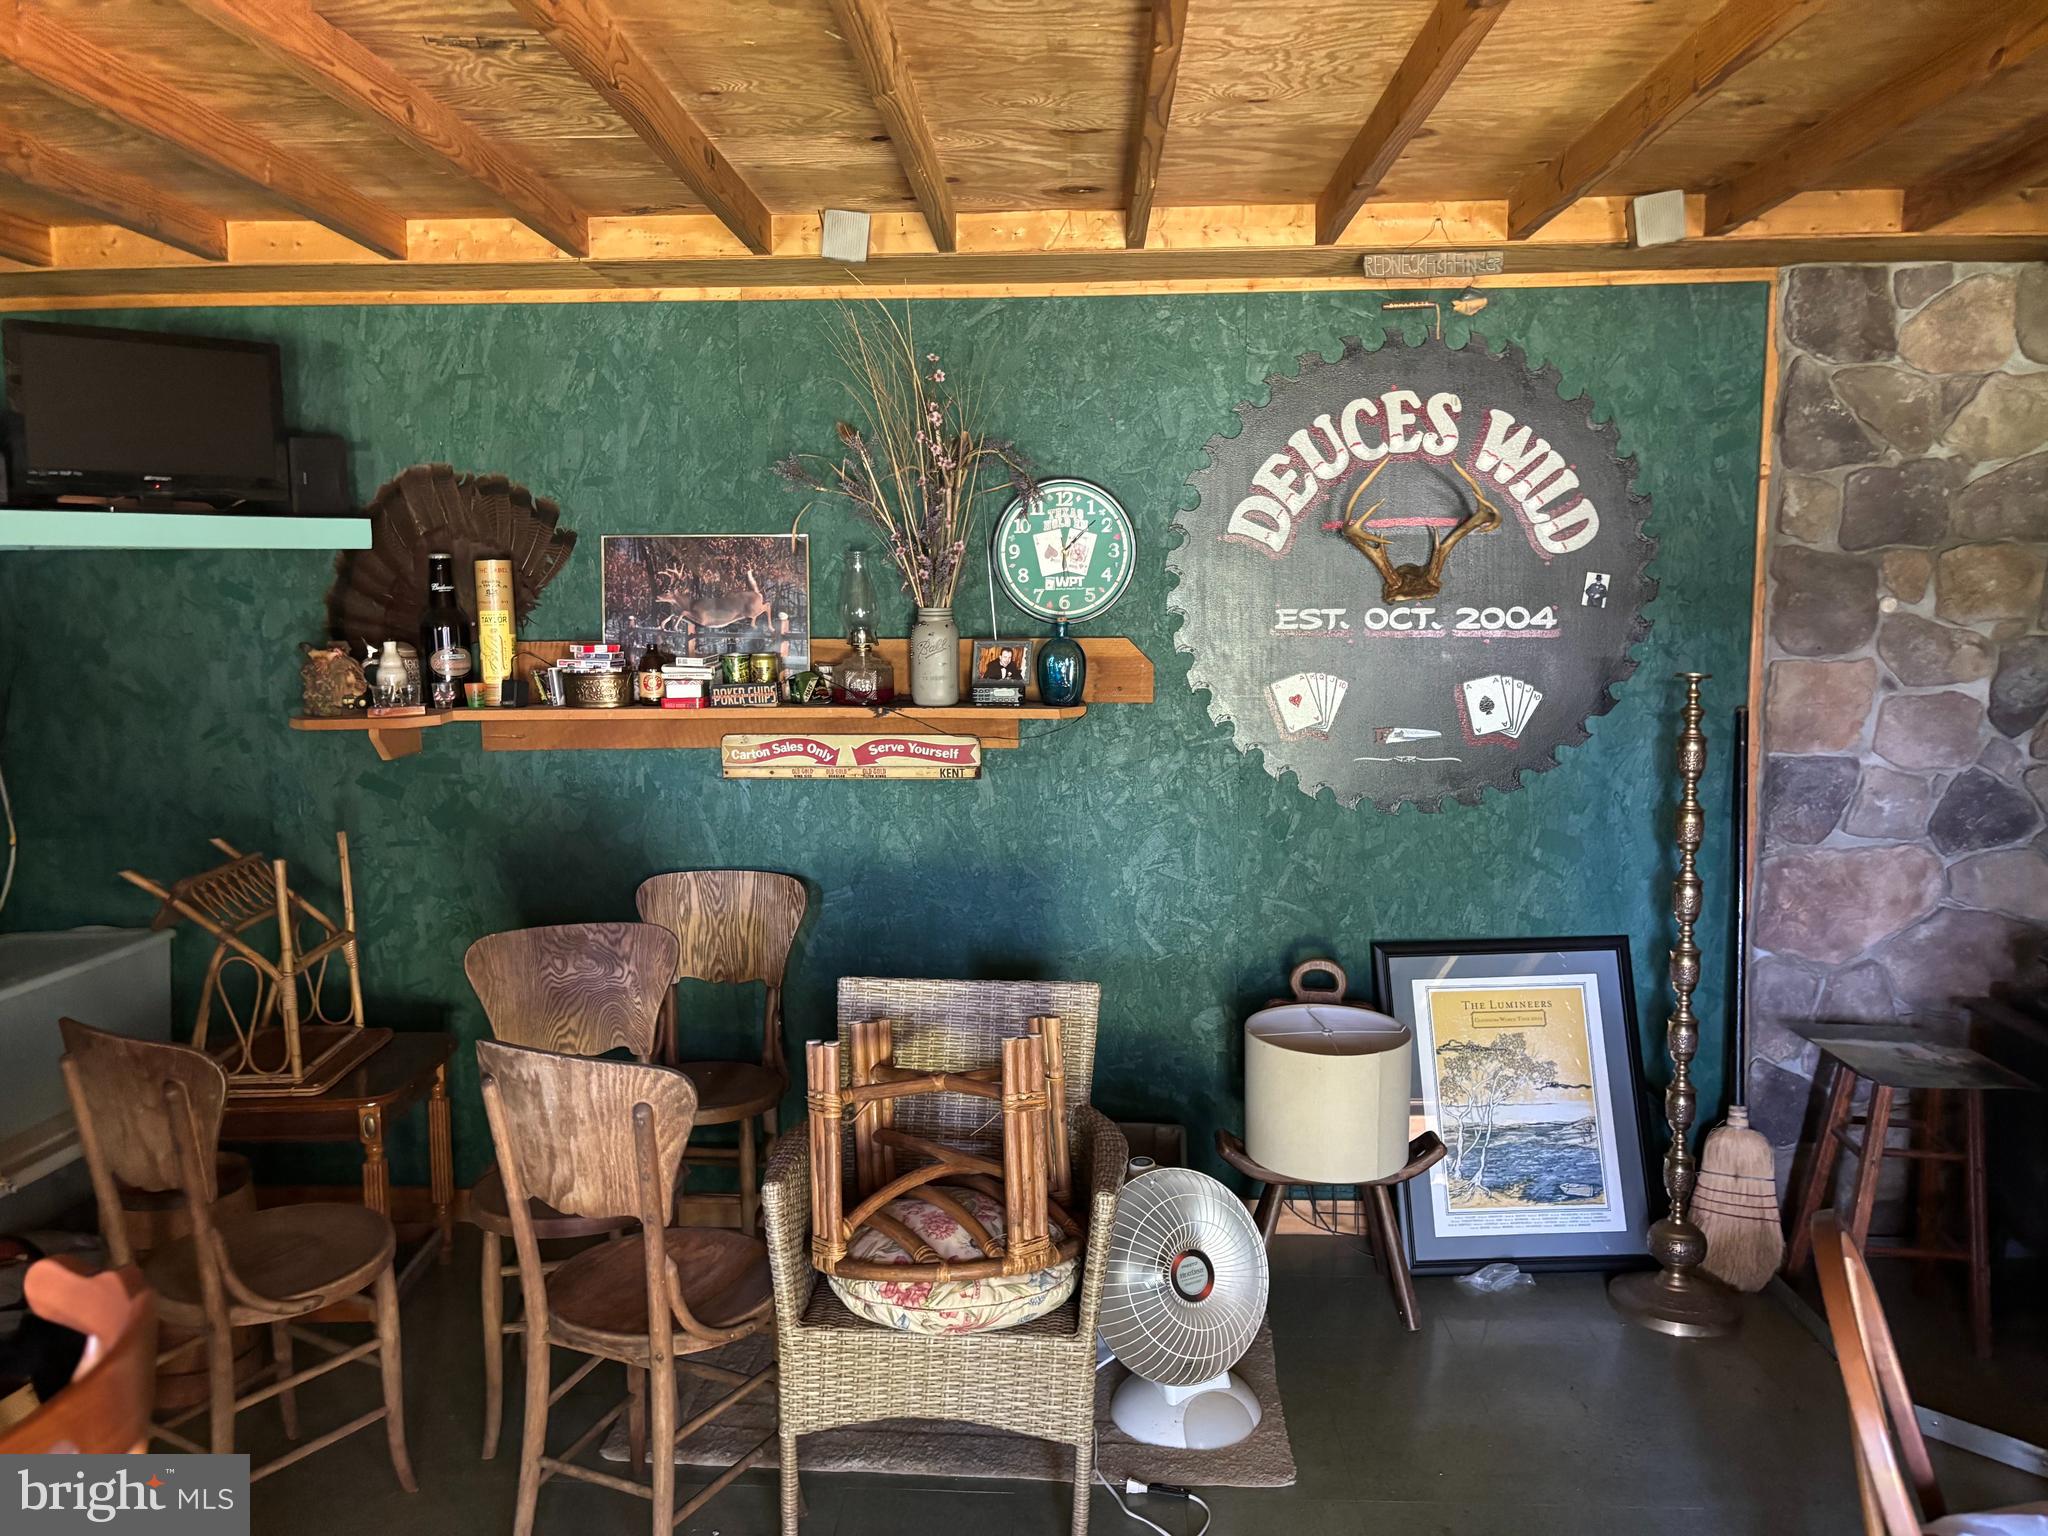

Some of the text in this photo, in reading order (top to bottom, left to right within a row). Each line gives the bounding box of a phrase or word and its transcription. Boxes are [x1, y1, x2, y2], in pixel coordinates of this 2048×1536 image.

[1365, 254, 1424, 276] REDNECK
[1227, 390, 1600, 554] DEUCES WILD
[1055, 491, 1074, 507] 12
[1087, 499, 1096, 515] 1
[1030, 499, 1045, 516] 11
[1047, 506, 1085, 520] TEXAS
[1013, 518, 1031, 534] 10
[1101, 517, 1113, 533] 2
[1008, 544, 1020, 559] 9
[1107, 543, 1120, 558] 3
[1017, 568, 1029, 583] 8
[1055, 576, 1085, 588] WPT
[1101, 567, 1113, 582] 4
[1033, 588, 1045, 603] 7
[1058, 594, 1071, 610] 6
[1084, 587, 1096, 602] 5
[1274, 606, 1558, 630] EST. OCT. 2004
[917, 638, 948, 660] Ball
[711, 684, 777, 706] POKER CHIPS
[731, 741, 834, 762] Carton Sales Only
[868, 742, 960, 759] Serve Yourself
[940, 768, 966, 779] KENT
[1460, 1000, 1553, 1010] THE LUMINEERS
